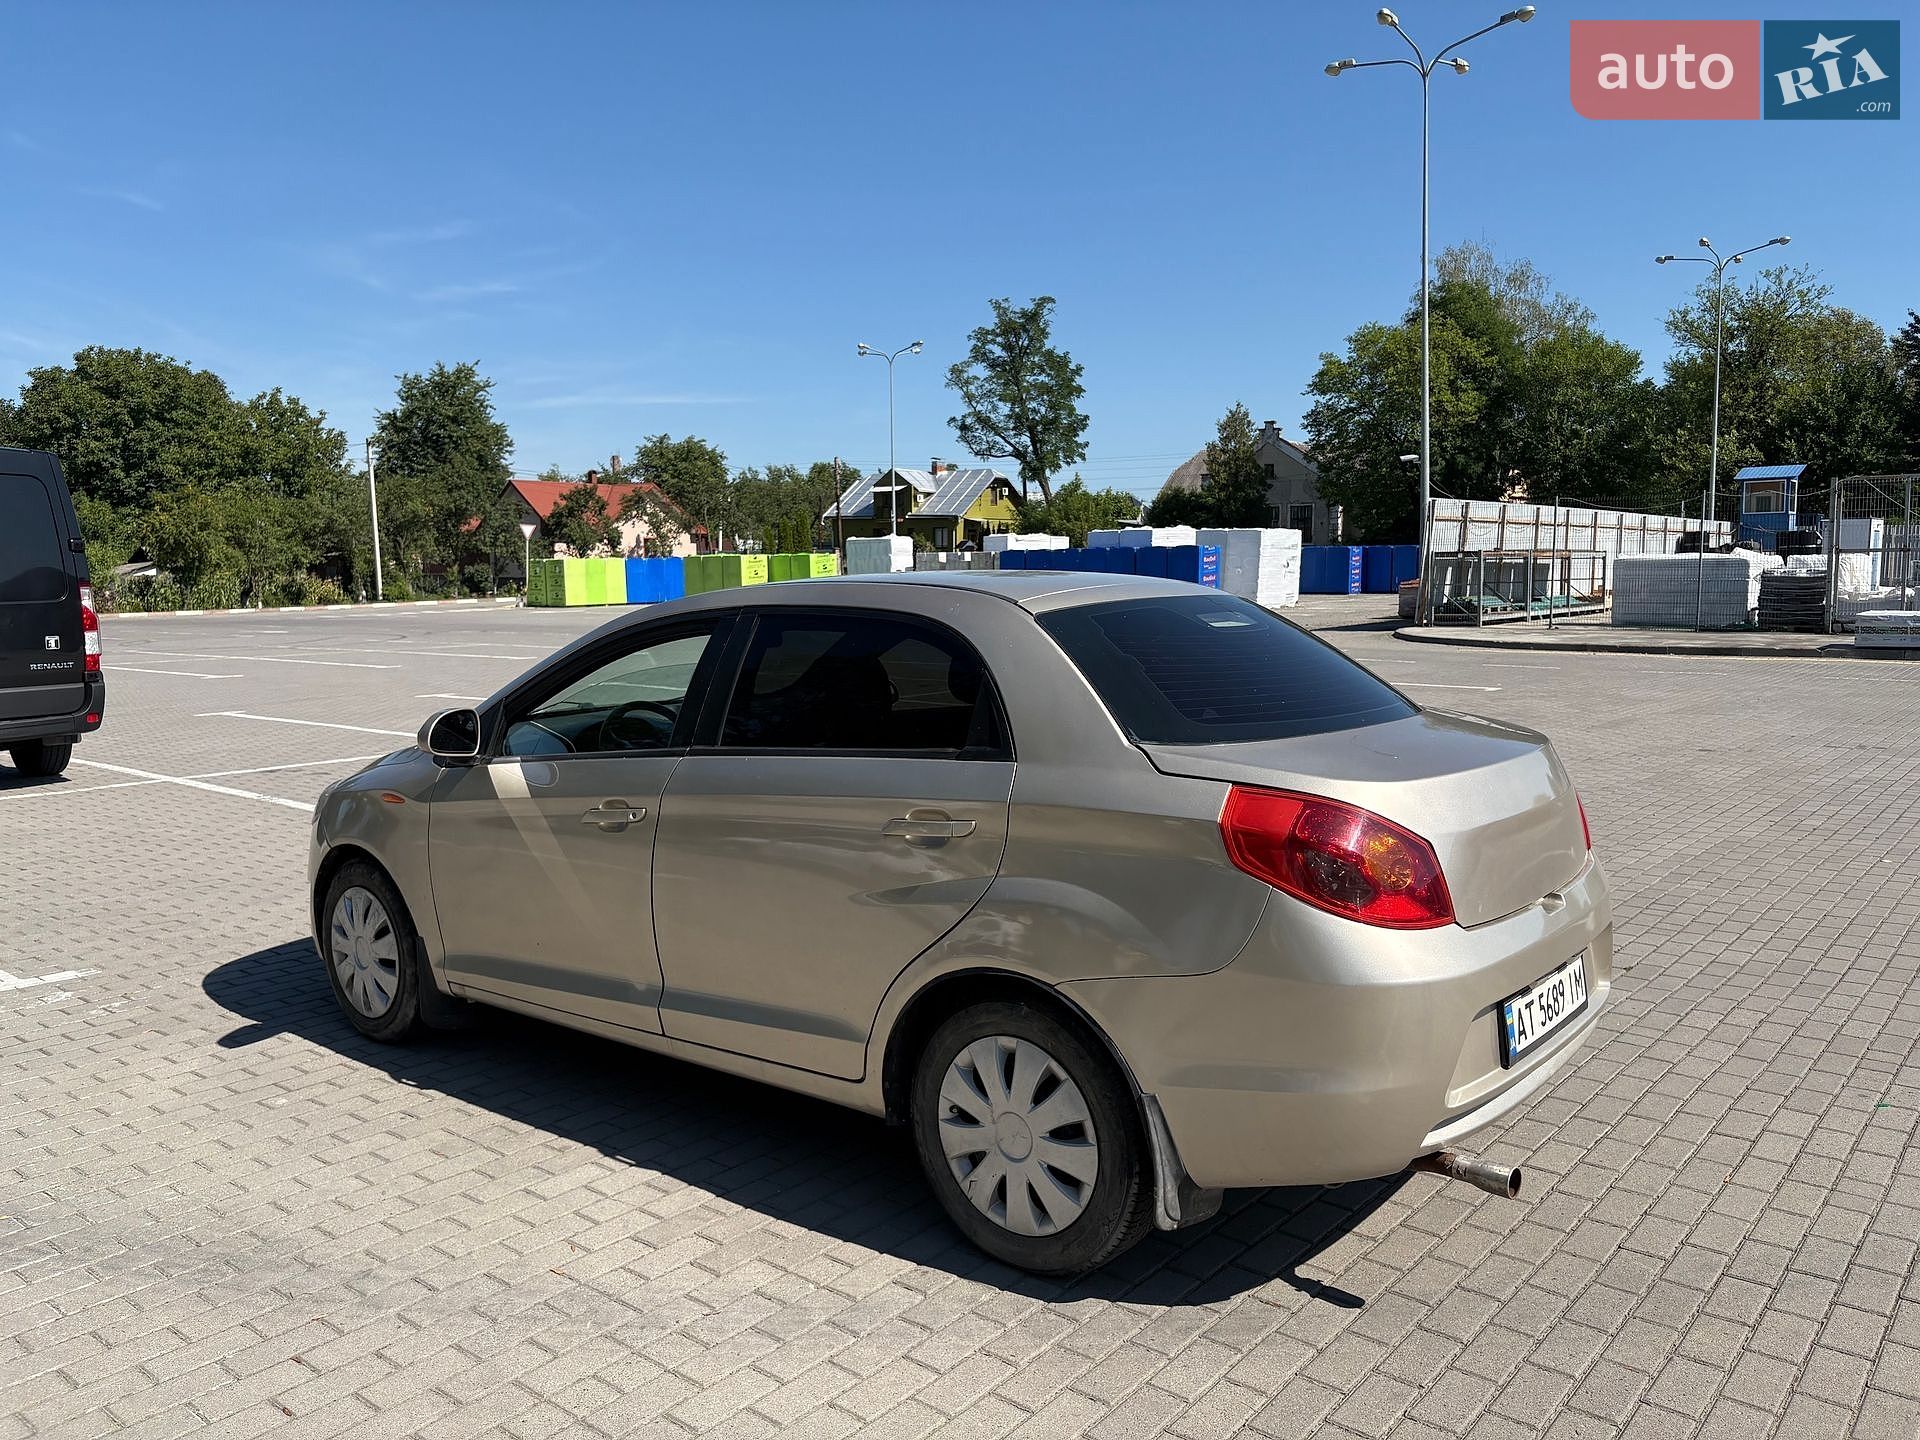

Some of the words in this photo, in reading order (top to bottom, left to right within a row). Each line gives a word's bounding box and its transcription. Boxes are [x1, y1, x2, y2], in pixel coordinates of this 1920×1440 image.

[30, 662, 74, 670] RENAULT
[1517, 999, 1535, 1045] AT
[1538, 979, 1565, 1027] 5689
[1569, 965, 1584, 1004] IM
